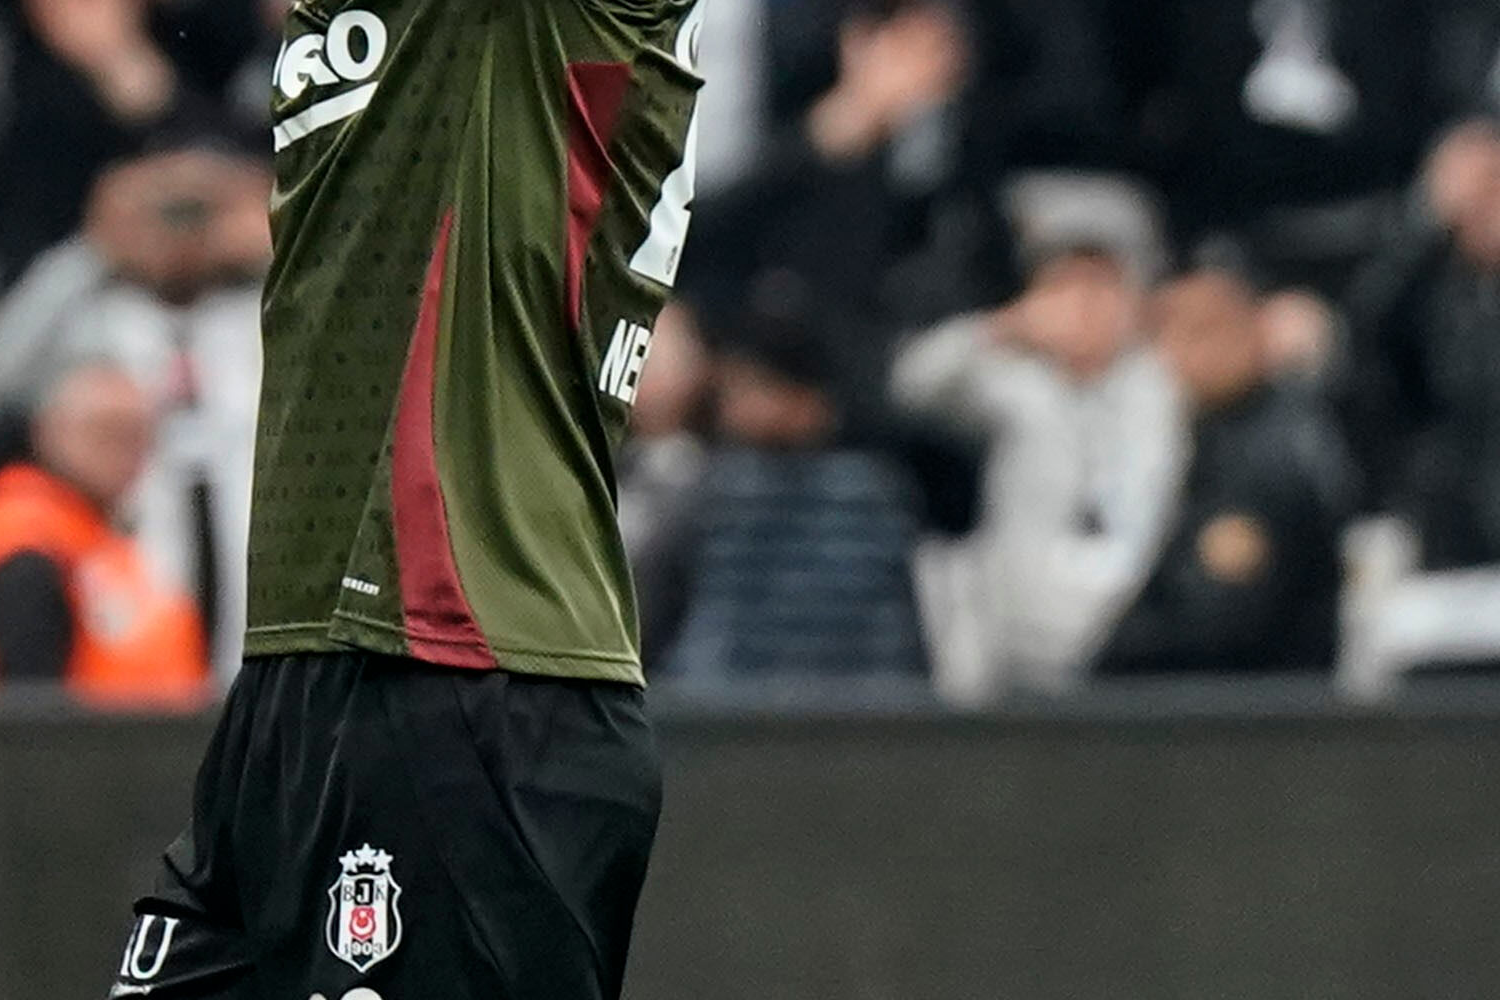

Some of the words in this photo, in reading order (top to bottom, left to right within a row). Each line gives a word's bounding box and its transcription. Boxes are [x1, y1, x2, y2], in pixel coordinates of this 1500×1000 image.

[598, 318, 652, 406] NE
[343, 881, 386, 903] BJK
[343, 941, 383, 956] 1903
